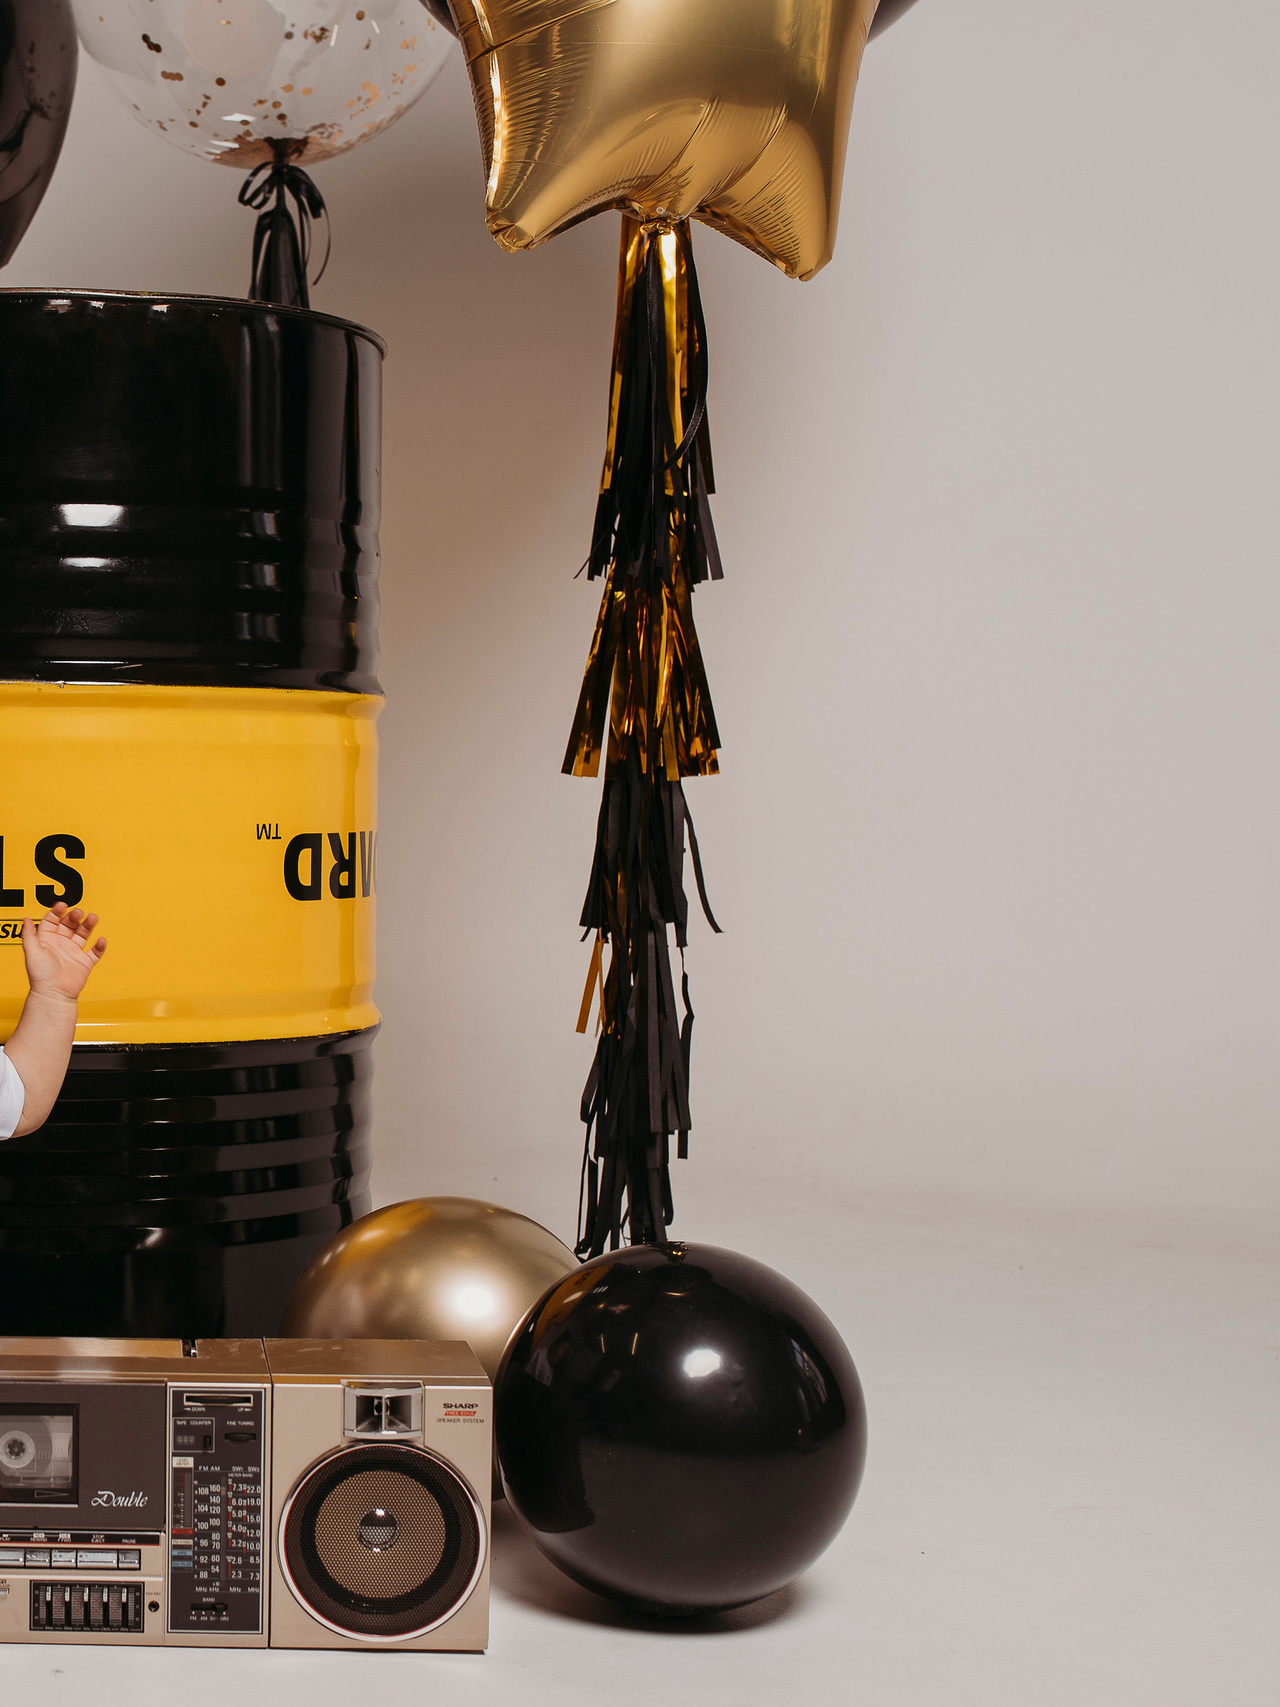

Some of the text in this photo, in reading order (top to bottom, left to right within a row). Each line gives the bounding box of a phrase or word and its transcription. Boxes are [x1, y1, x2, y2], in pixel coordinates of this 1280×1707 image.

[256, 823, 379, 902] ARD TM
[198, 1487, 209, 1495] 108
[209, 1484, 221, 1492] 160
[246, 1485, 261, 1493] 22.0
[90, 1489, 149, 1508] Double
[209, 1495, 221, 1504] 140
[246, 1498, 261, 1506] 19.0
[198, 1504, 209, 1512] 104
[209, 1506, 221, 1514] 120
[246, 1514, 261, 1523] 15.0
[198, 1523, 209, 1531] 100
[209, 1518, 221, 1526] 100
[246, 1529, 261, 1538] 12.0
[211, 1532, 221, 1541] 80
[211, 1541, 221, 1549] 70
[199, 1555, 208, 1563] 92
[199, 1570, 208, 1578] 88
